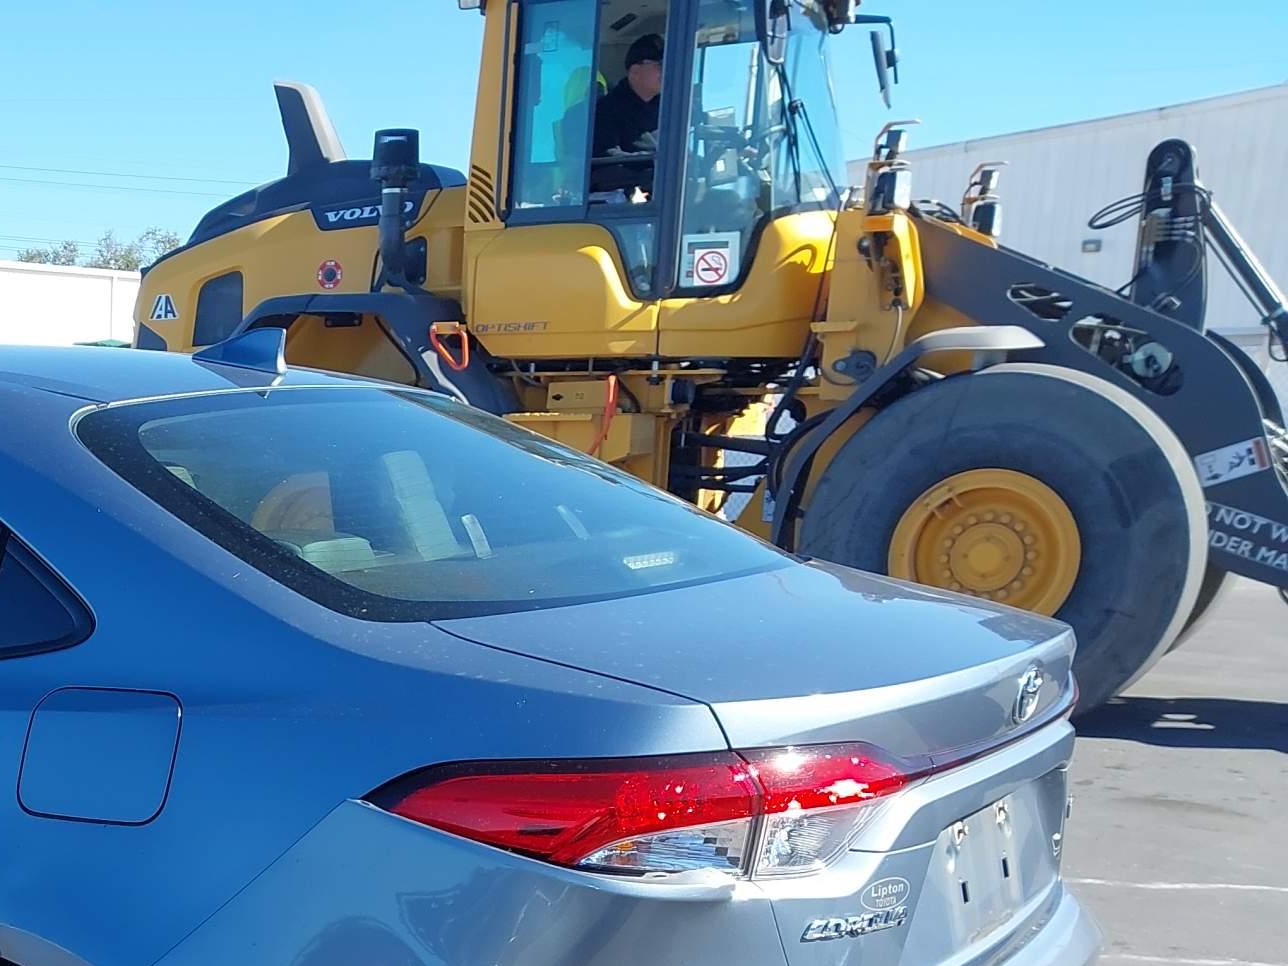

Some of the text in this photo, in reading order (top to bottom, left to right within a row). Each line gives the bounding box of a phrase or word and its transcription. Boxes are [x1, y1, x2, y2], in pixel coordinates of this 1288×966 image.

[1215, 507, 1268, 534] NOT
[1209, 530, 1253, 558] DER
[871, 883, 904, 898] Lipton
